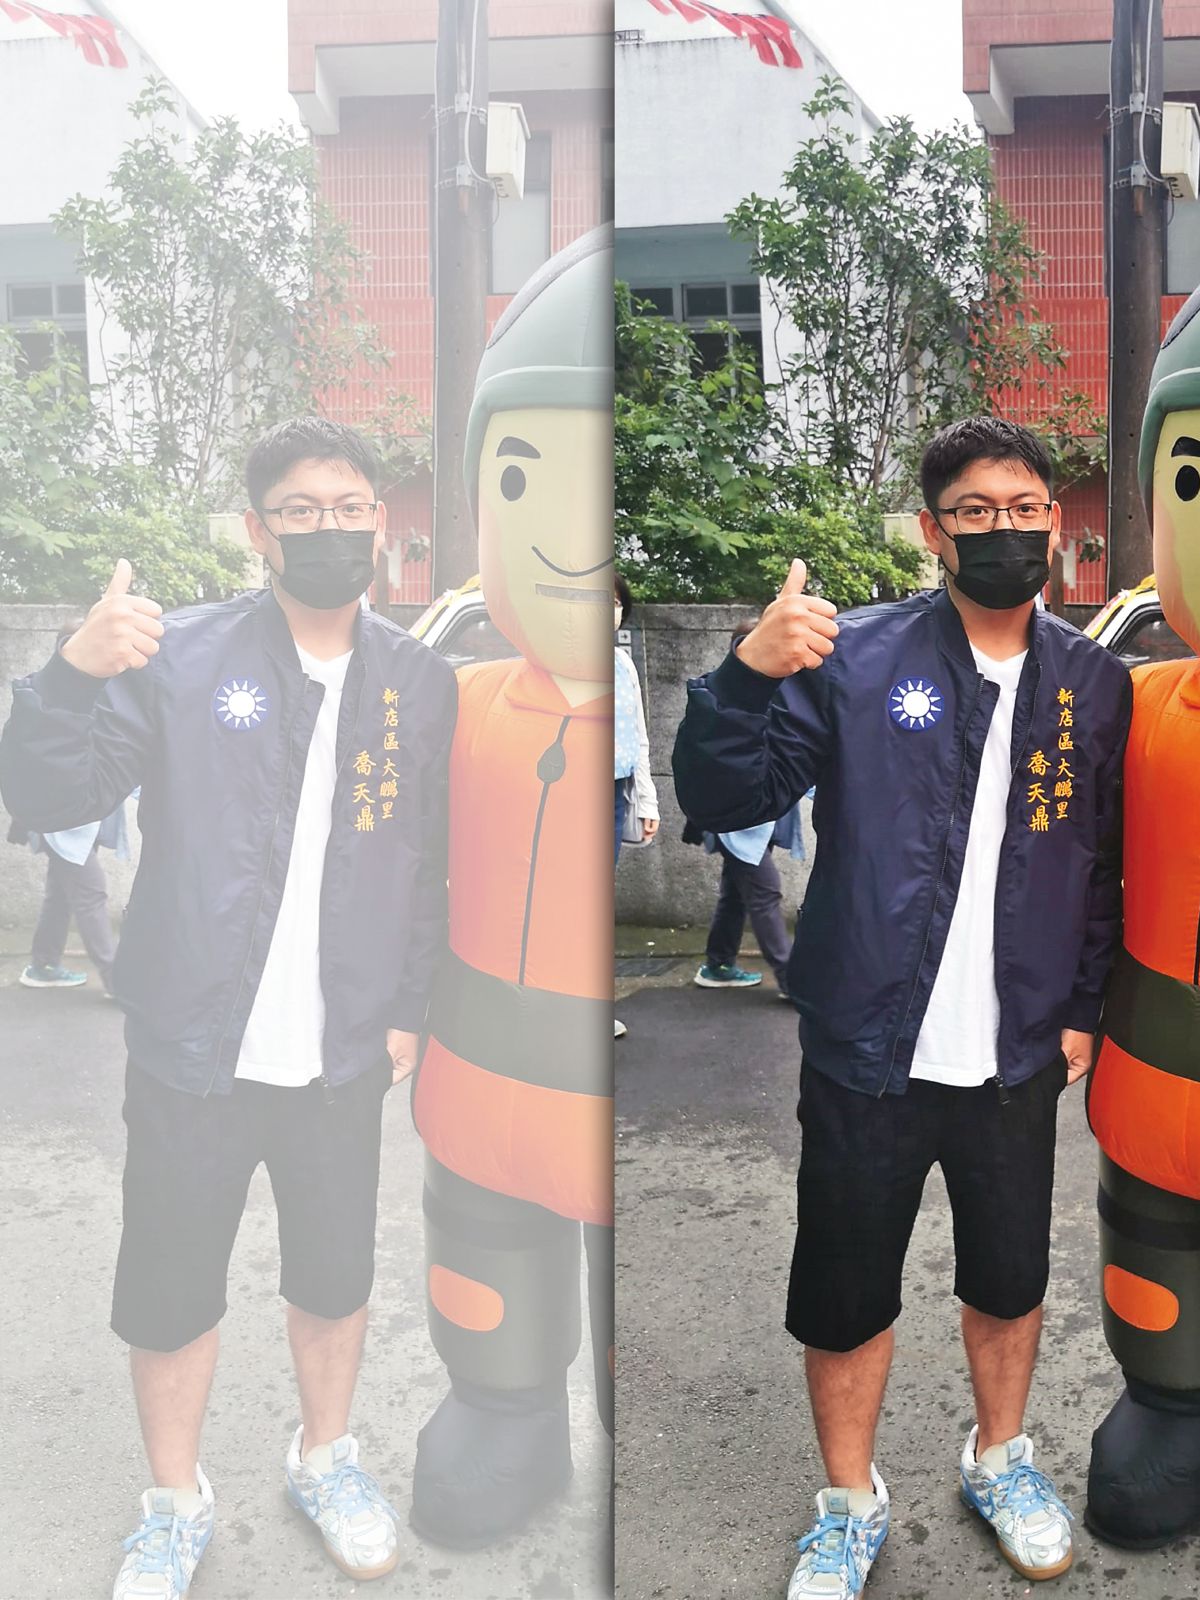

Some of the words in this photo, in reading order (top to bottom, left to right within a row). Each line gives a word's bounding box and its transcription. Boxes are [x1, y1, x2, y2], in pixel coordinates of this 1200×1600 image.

[353, 750, 377, 832] 喬天鼎
[380, 688, 401, 819] 新店區大鵬里
[1027, 750, 1051, 832] 喬天鼎
[1054, 688, 1075, 819] 新店區大鵬里
